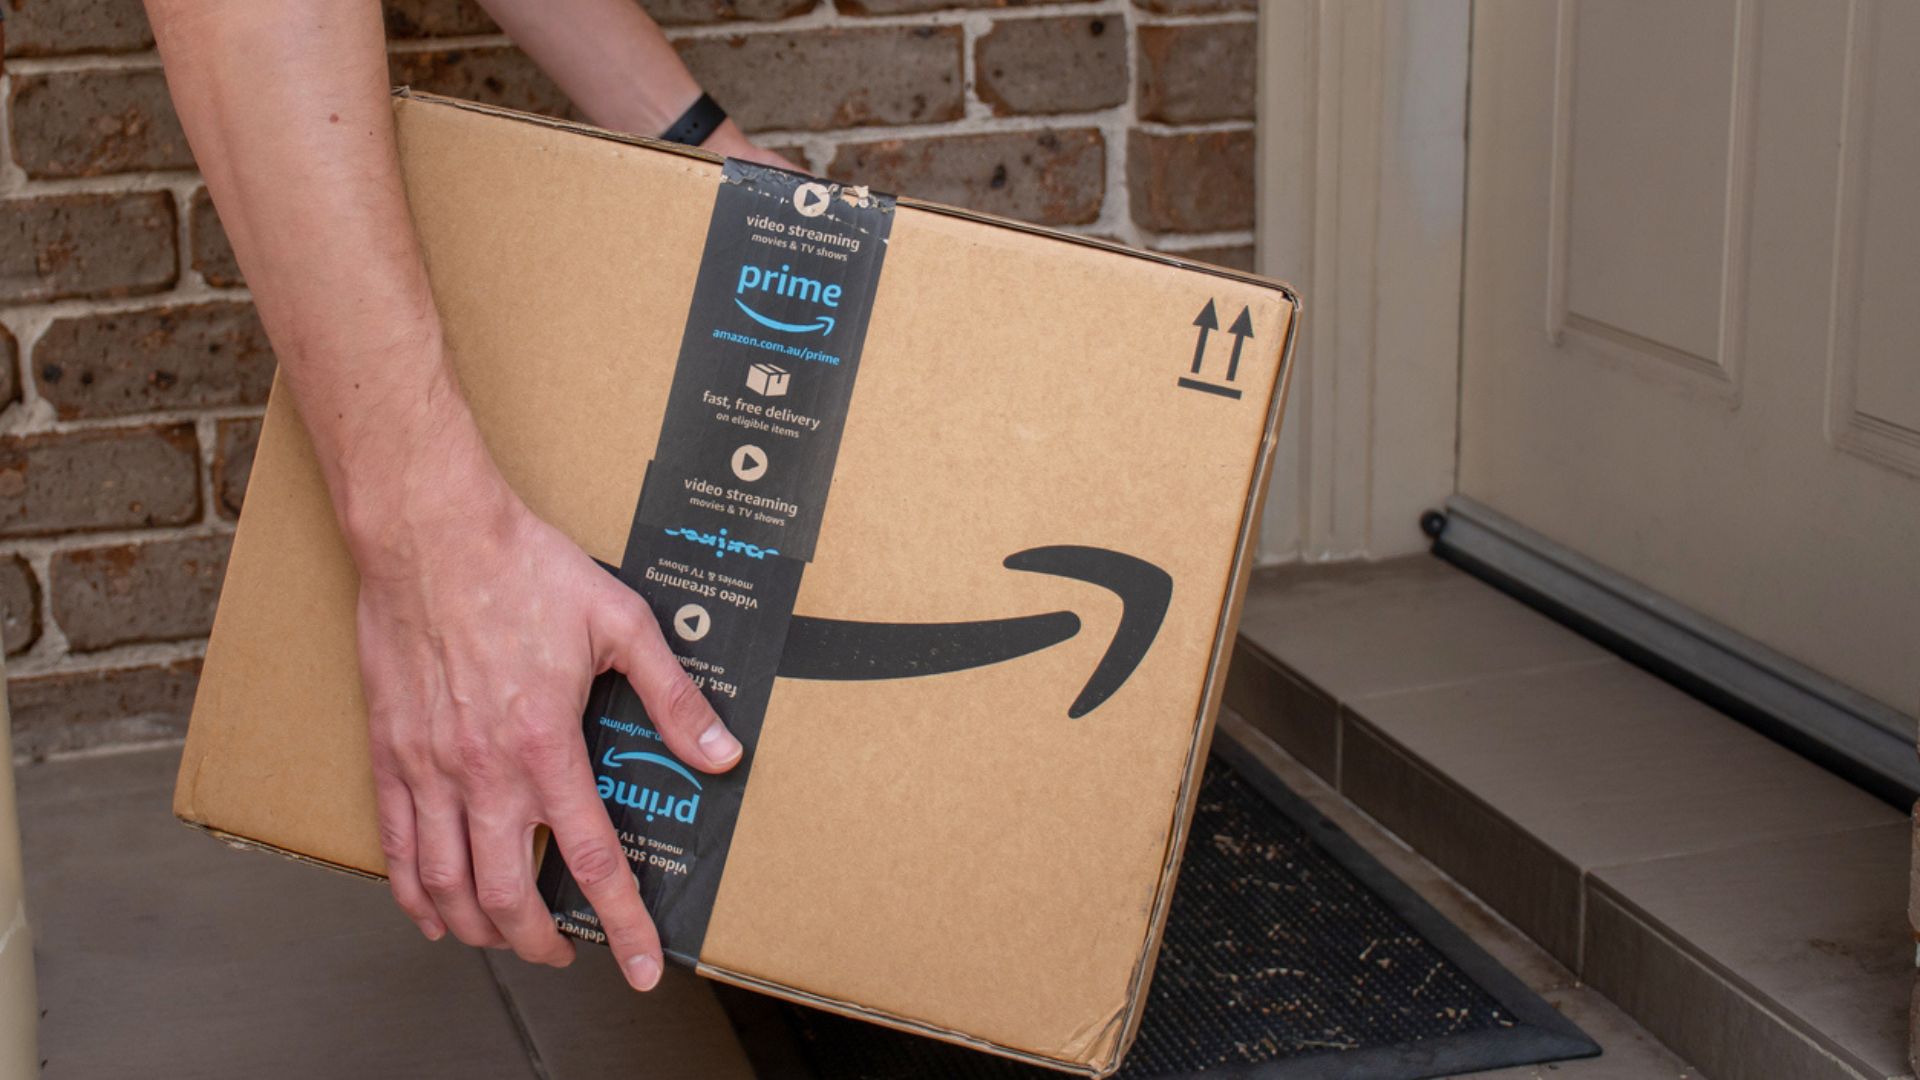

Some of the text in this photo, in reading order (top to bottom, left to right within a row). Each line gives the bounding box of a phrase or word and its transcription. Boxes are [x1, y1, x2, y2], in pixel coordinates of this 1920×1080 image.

[746, 214, 860, 252] video streaming
[751, 233, 848, 262] movies & TV shows
[736, 264, 842, 308] prime
[712, 327, 840, 366] amazon.com.au/prime
[703, 390, 821, 431] fast, free delivery
[716, 412, 800, 438] on eligible items
[684, 477, 798, 517] video streaming
[689, 496, 785, 527] movies & TV shows
[645, 567, 758, 610] video streaming
[658, 558, 754, 590] movies & TV shows
[711, 664, 725, 675] on
[709, 676, 737, 698] fast,
[597, 775, 700, 825] prime
[620, 831, 635, 844] TV
[638, 835, 646, 847] &
[647, 839, 683, 856] movies
[648, 854, 688, 876] video
[572, 910, 598, 927] items
